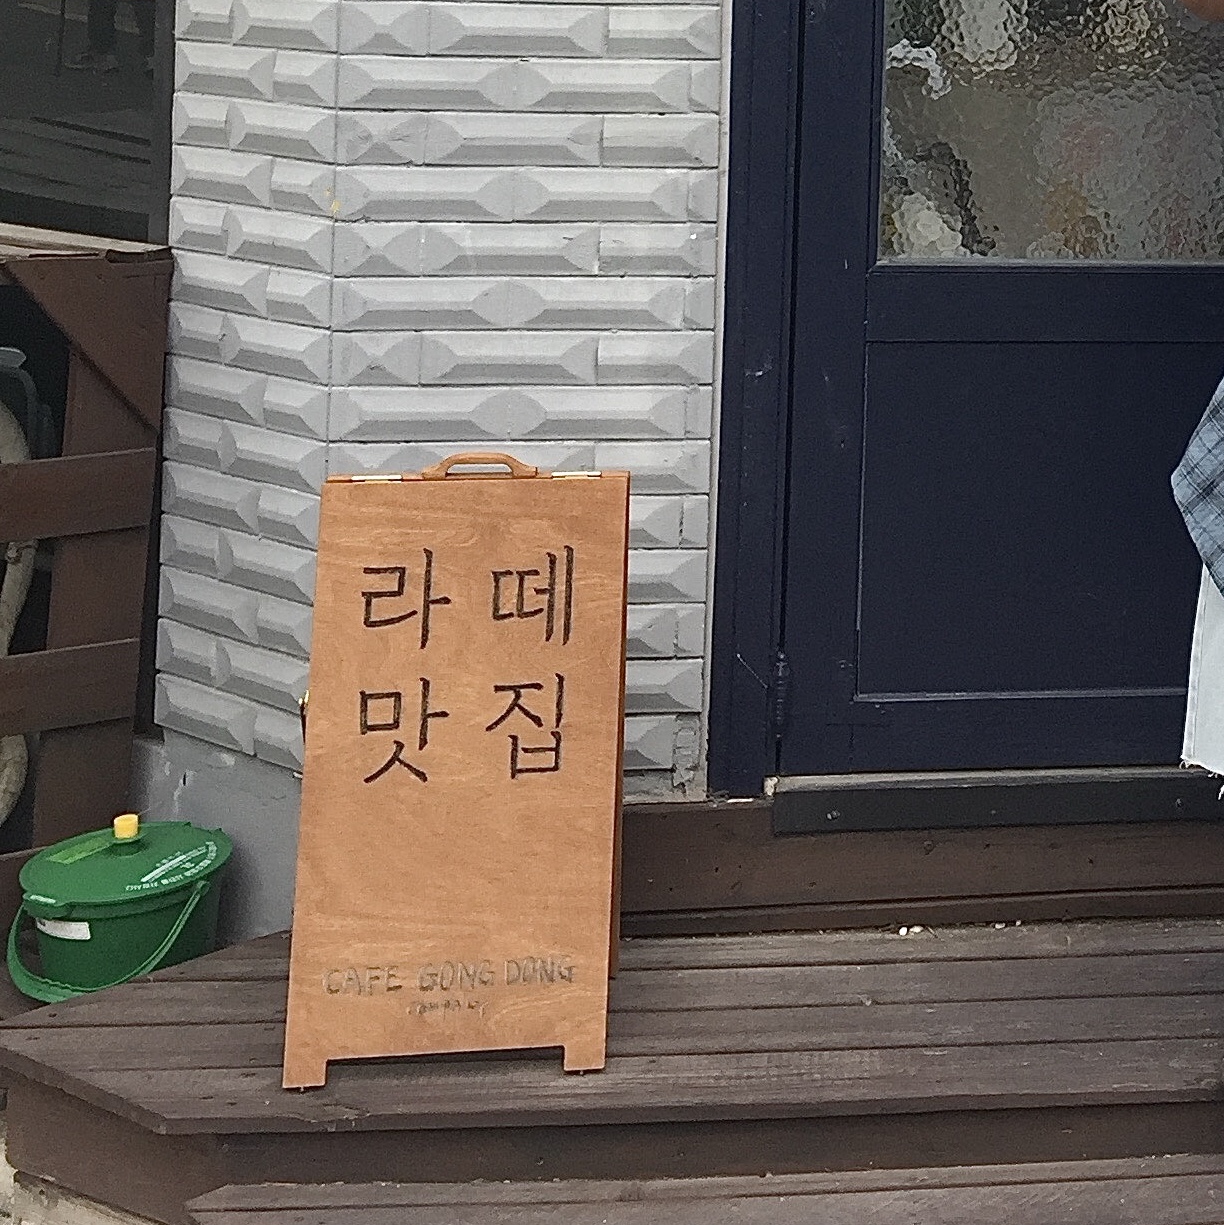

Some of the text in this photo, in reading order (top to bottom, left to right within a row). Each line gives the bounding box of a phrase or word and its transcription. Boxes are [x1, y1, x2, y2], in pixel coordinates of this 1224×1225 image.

[360, 544, 576, 650] 라떼
[358, 672, 568, 784] 맛집
[321, 954, 577, 996] CAFE GONG DONG
